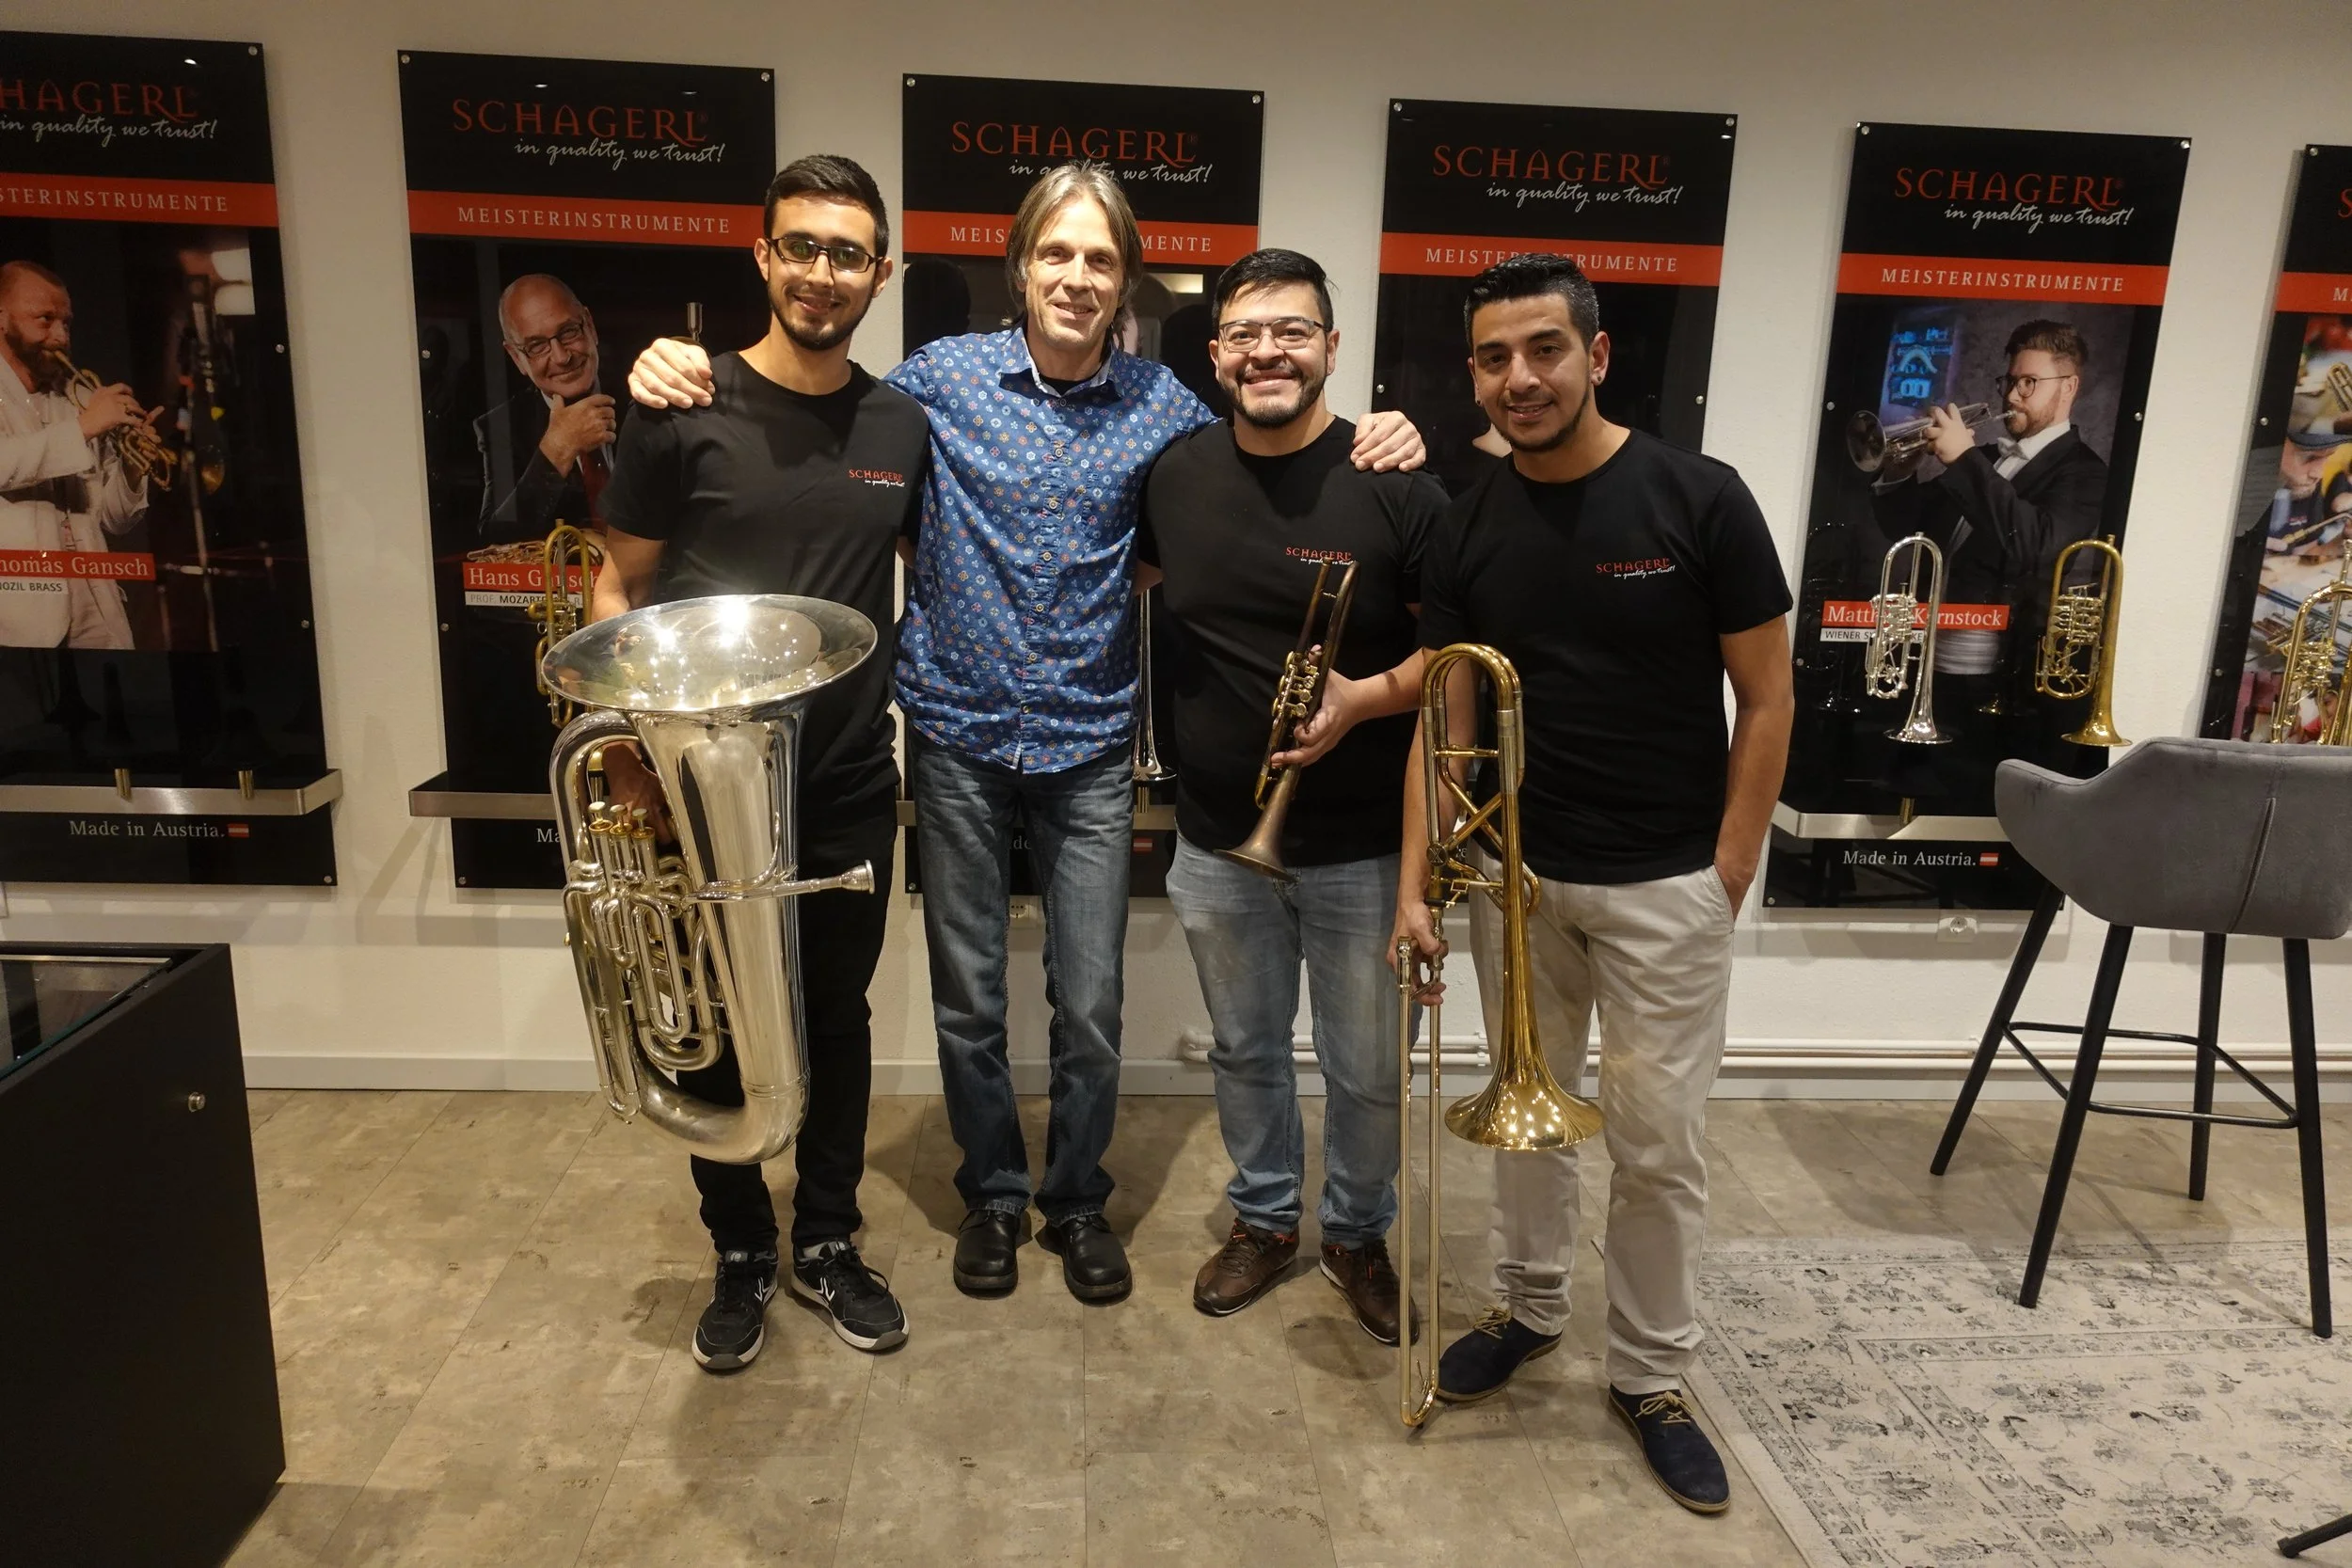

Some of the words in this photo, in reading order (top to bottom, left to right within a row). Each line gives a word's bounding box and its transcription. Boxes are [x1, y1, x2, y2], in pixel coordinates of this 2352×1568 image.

[0, 114, 24, 131] in
[32, 114, 117, 148] quality
[121, 125, 151, 137] we
[151, 119, 218, 140] trust!
[515, 138, 540, 155] in
[547, 137, 628, 170] quality
[632, 149, 660, 160] we
[661, 143, 726, 163] trust!
[1009, 159, 1033, 175] in
[1123, 170, 1149, 182] we
[1150, 164, 1214, 183] trust!
[1486, 182, 1510, 198] in
[1516, 182, 1590, 213] quality
[1596, 192, 1621, 202] we
[1622, 185, 1684, 205] trust!
[457, 206, 730, 234] MEISTERINSTRUMENTE
[1944, 203, 1967, 219] in
[1972, 202, 2044, 234] quality
[2049, 214, 2073, 224] we
[2073, 207, 2135, 226] trust!
[1882, 268, 2124, 293] MEISTERINSTRUMENTE
[72, 557, 149, 577] Gansch
[469, 567, 520, 586] Hans
[30, 582, 62, 593] BRASS
[1914, 610, 2003, 626] Krnstock
[1825, 630, 1861, 641] WIENER
[69, 820, 119, 836] Made
[127, 821, 145, 836] in
[152, 821, 226, 837] Austria.
[1842, 849, 1887, 865] Made
[1892, 850, 1908, 865] in
[1914, 850, 1977, 866] Austria.
